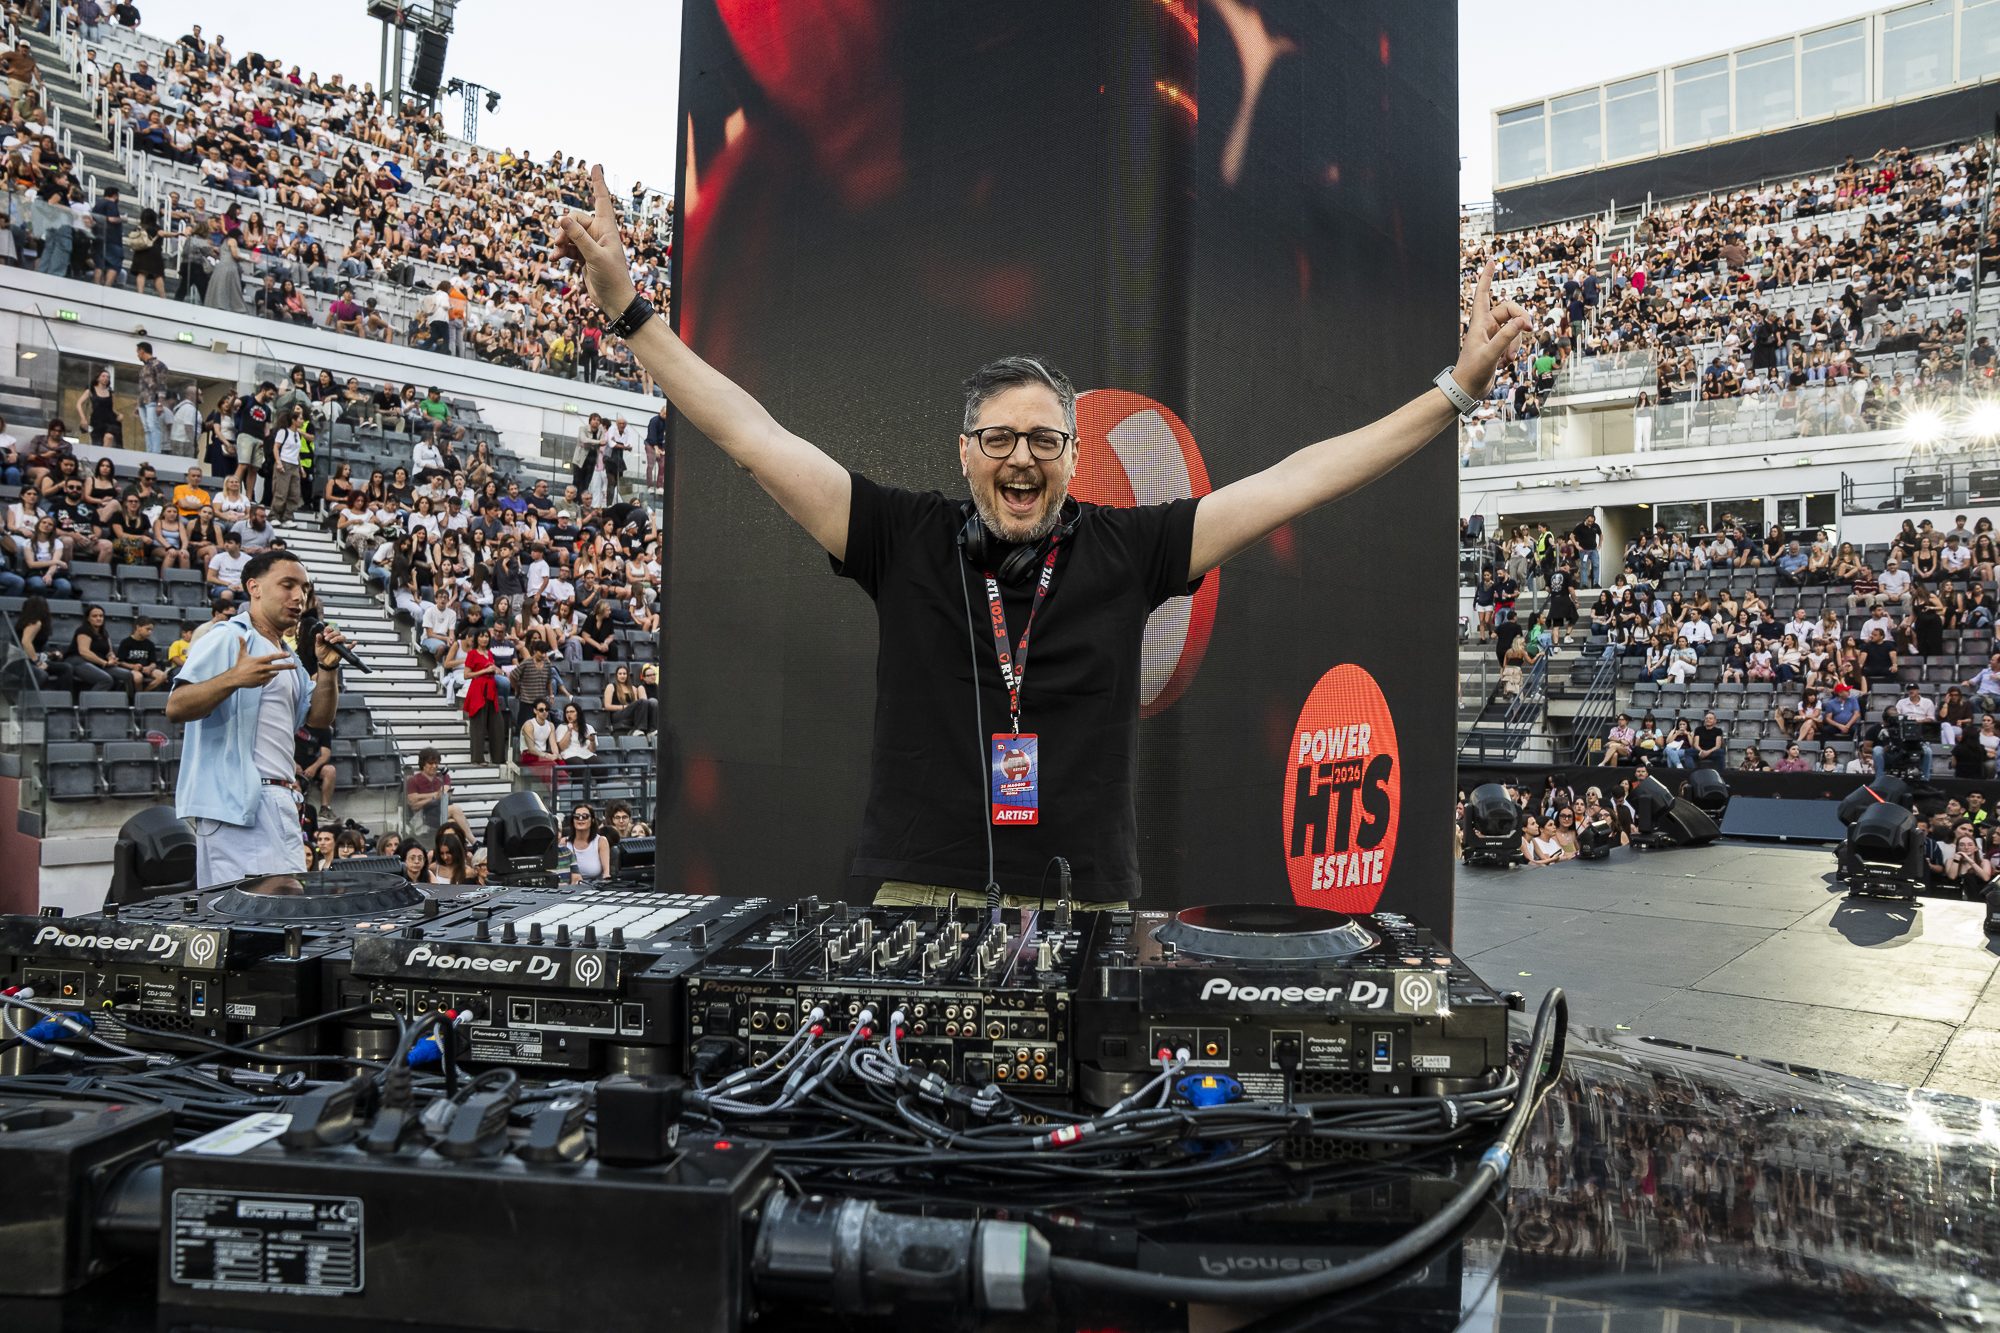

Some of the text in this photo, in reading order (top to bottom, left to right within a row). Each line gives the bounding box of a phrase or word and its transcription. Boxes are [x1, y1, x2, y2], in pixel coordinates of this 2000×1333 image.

[1298, 723, 1371, 765] POWER
[1334, 766, 1360, 784] 2026
[996, 810, 1035, 820] ARTIST
[1311, 849, 1385, 891] ESTATE
[34, 926, 144, 951] Pioneer
[405, 947, 522, 973] Pioneer
[703, 980, 771, 994] Pioneer
[1200, 978, 1342, 1002] Pioneer
